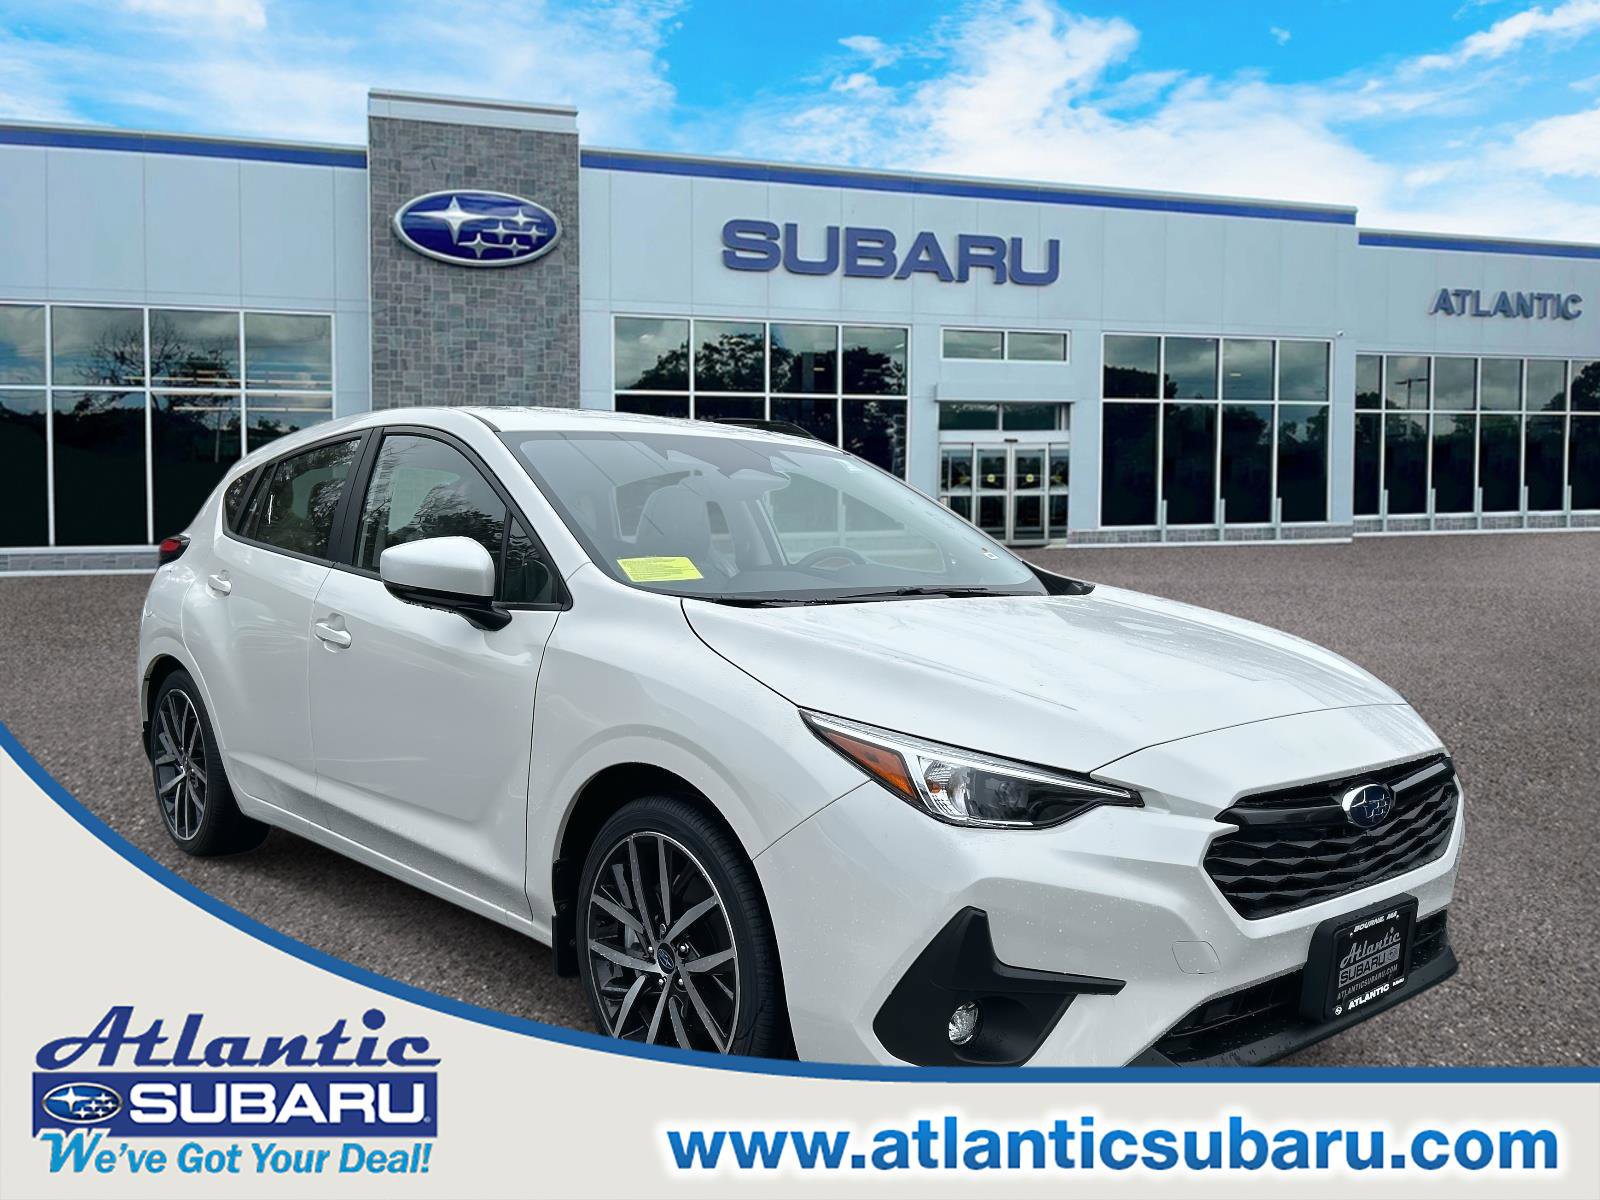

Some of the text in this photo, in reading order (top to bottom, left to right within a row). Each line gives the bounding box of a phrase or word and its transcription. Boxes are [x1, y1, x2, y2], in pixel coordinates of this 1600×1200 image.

[722, 218, 1060, 286] SUBARU
[1429, 288, 1583, 320] ATLANTIC
[1339, 927, 1401, 969] Atlantic
[1337, 963, 1398, 1000] ATLANTICSUBARU.COM
[1340, 951, 1386, 984] SUBARU
[1348, 983, 1390, 1010] ATLANTIC
